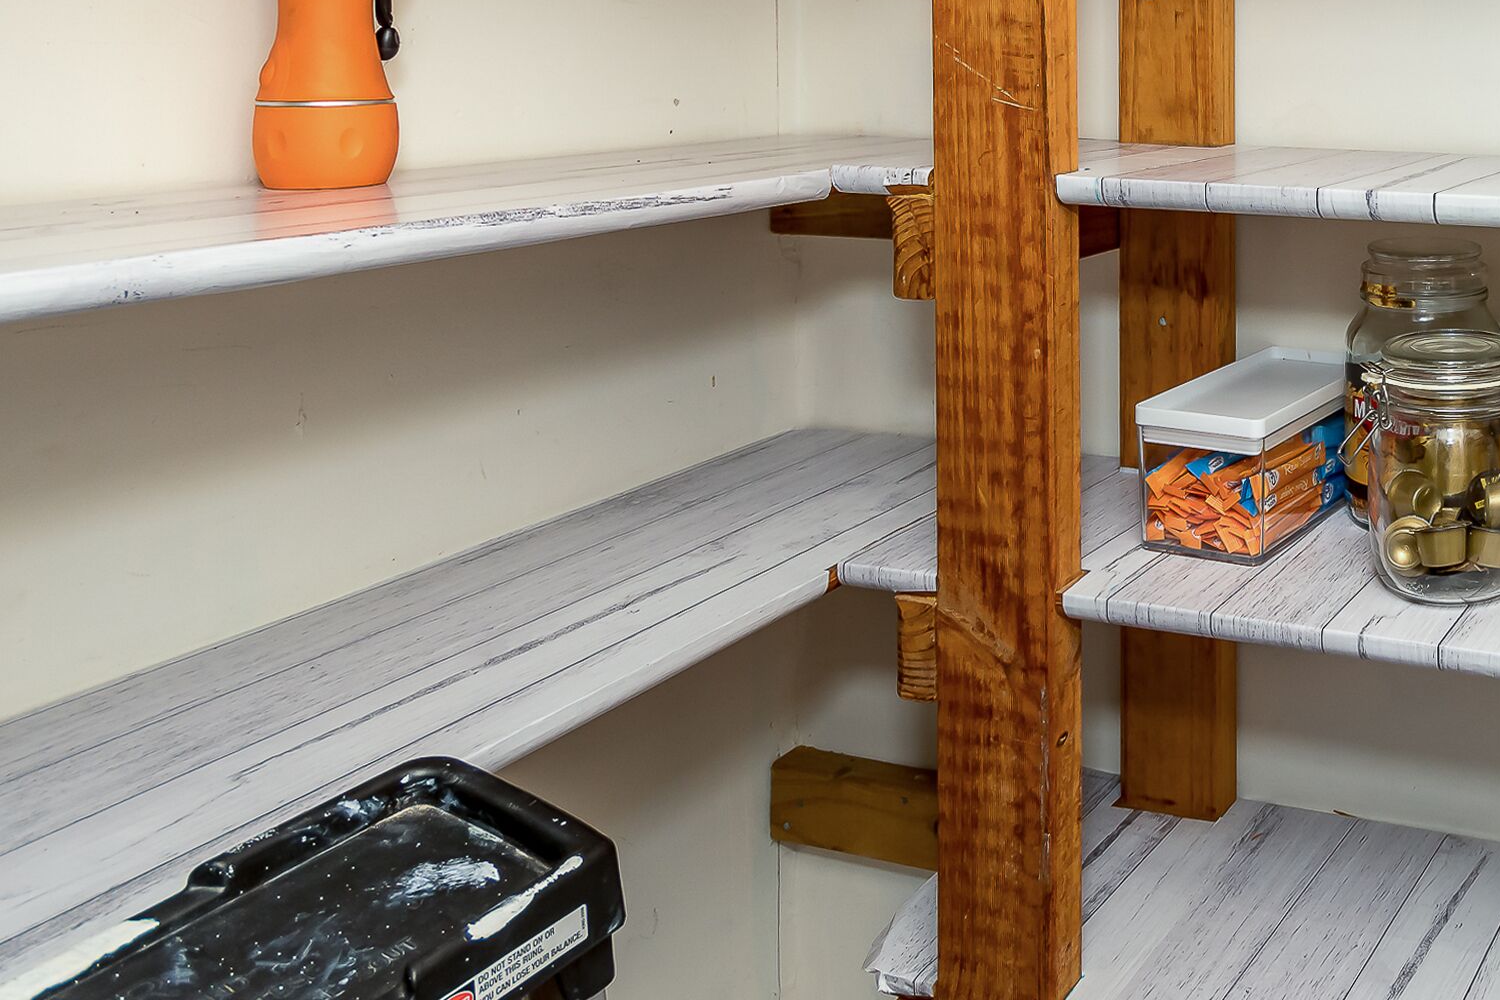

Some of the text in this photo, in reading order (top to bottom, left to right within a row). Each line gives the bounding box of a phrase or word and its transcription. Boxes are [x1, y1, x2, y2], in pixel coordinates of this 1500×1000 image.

[478, 927, 555, 984] DO NOT STAND ON OR
[479, 972, 504, 994] ABOVE
[505, 960, 521, 976] THIS
[482, 991, 495, 1000] OU
[495, 979, 511, 995] CAN
[512, 965, 531, 984] LOSE
[531, 952, 550, 970] YOUR
